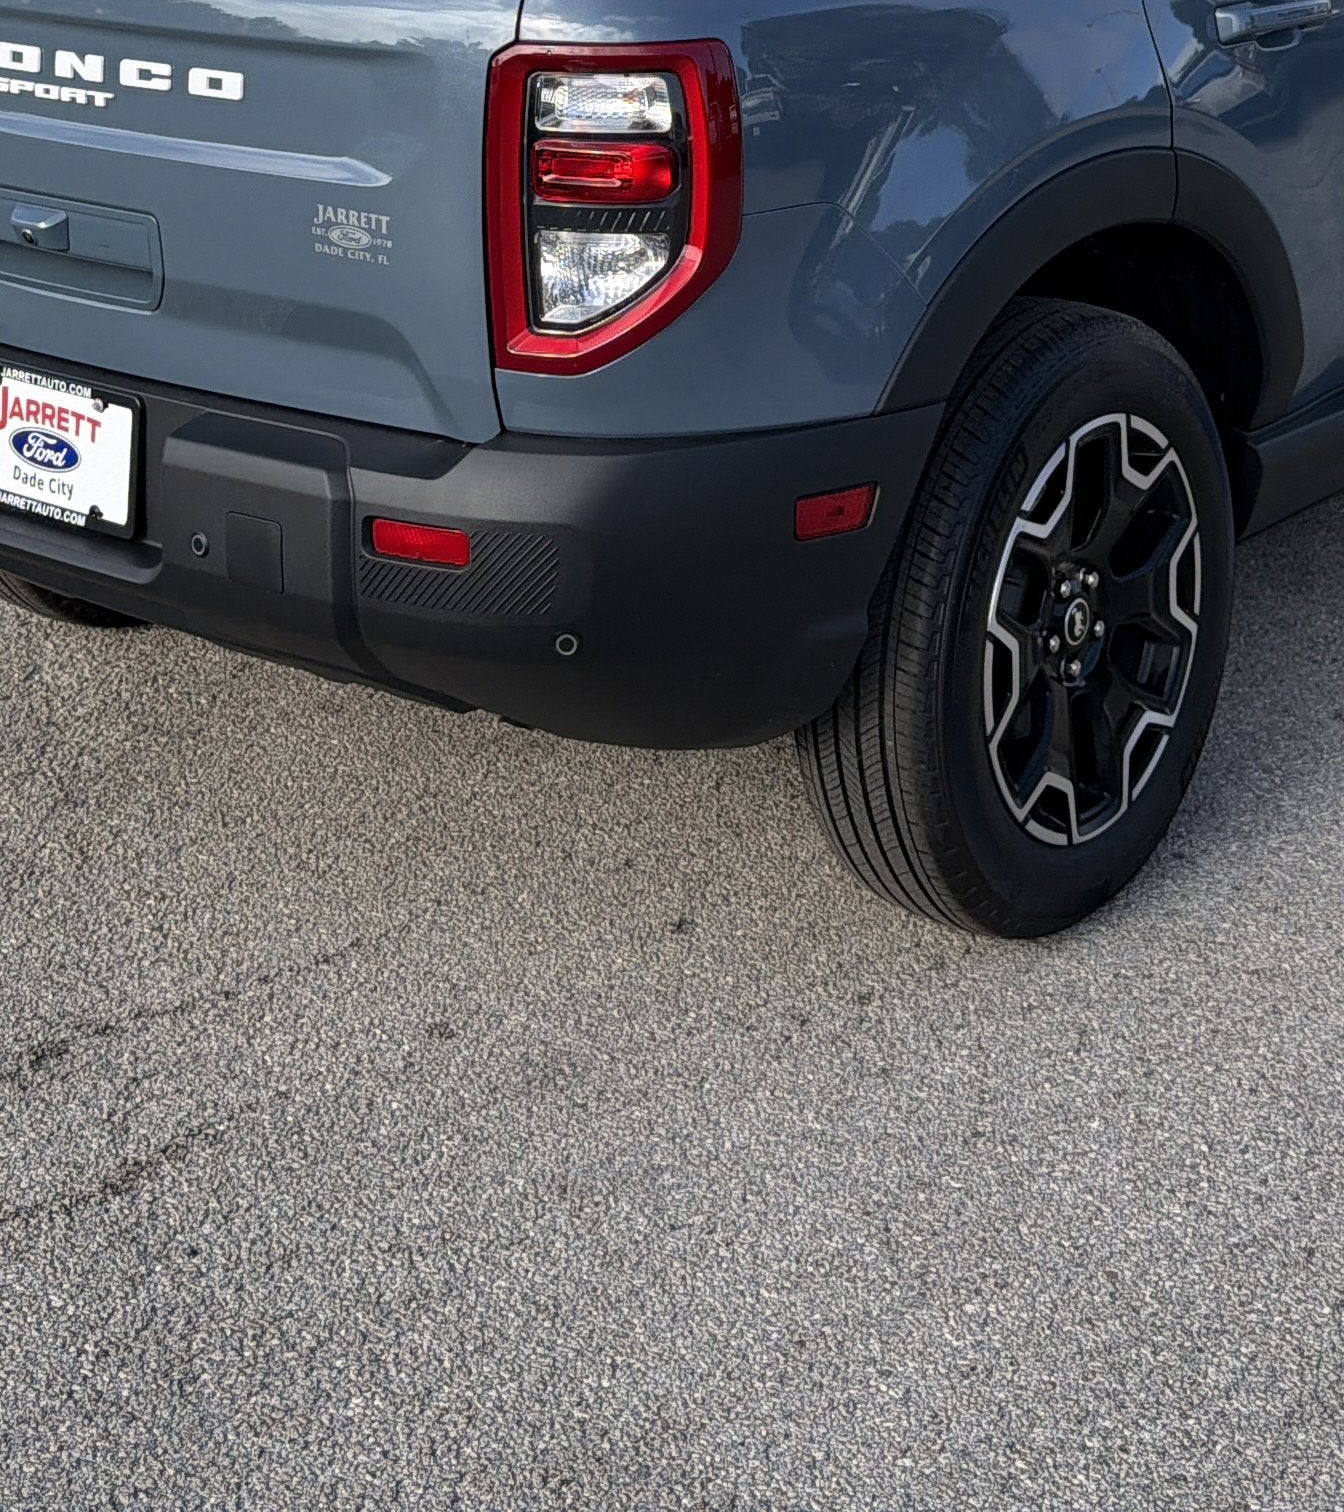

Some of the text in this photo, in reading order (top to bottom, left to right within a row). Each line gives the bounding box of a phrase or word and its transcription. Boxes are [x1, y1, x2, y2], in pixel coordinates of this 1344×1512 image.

[313, 203, 391, 235] JARRETT
[314, 242, 390, 266] DADE CITY, FL
[0, 366, 93, 399] JARRETTAUTO.COM
[22, 432, 68, 468] Ford
[13, 464, 75, 501] Dade City
